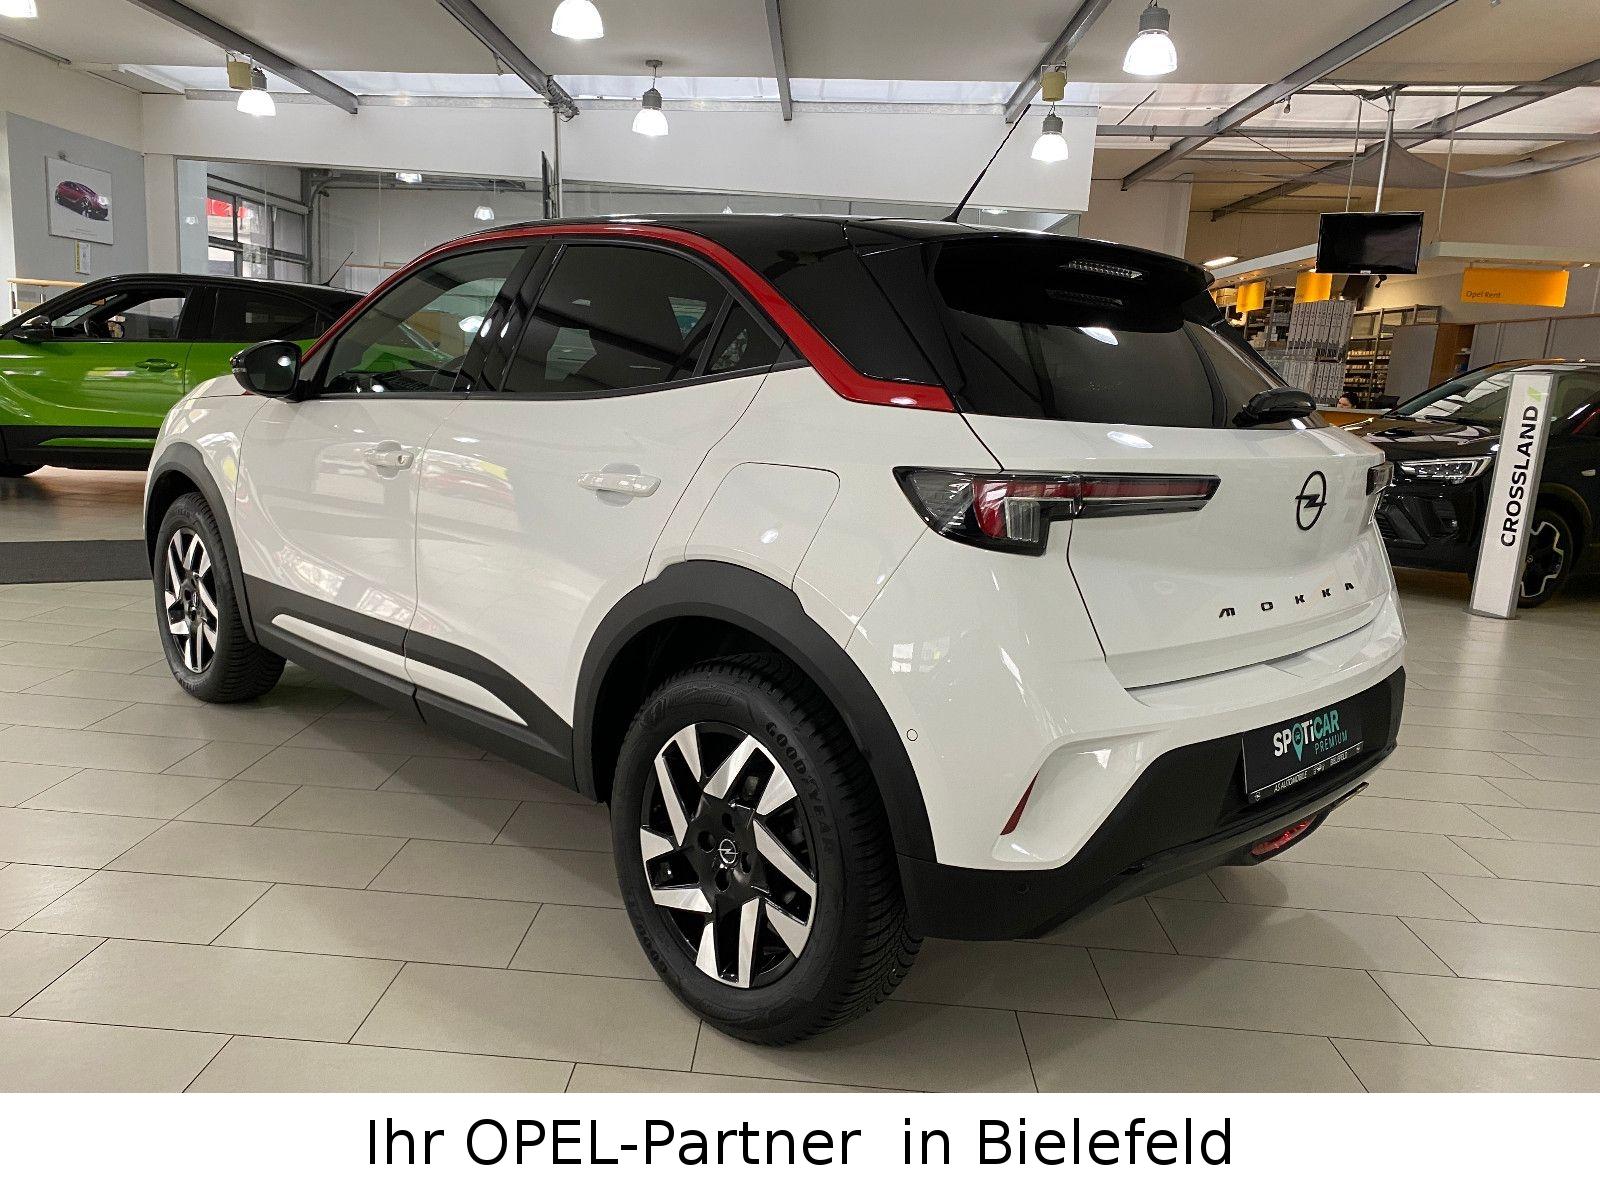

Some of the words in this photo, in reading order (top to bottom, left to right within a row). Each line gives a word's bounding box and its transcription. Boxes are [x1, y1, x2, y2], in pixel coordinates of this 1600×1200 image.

[1466, 290, 1483, 298] Opel
[1501, 405, 1538, 547] CROSSLAND
[1219, 582, 1354, 618] MOKKA
[1314, 729, 1348, 754] PREMIUM
[766, 721, 833, 856] GOODYEAR
